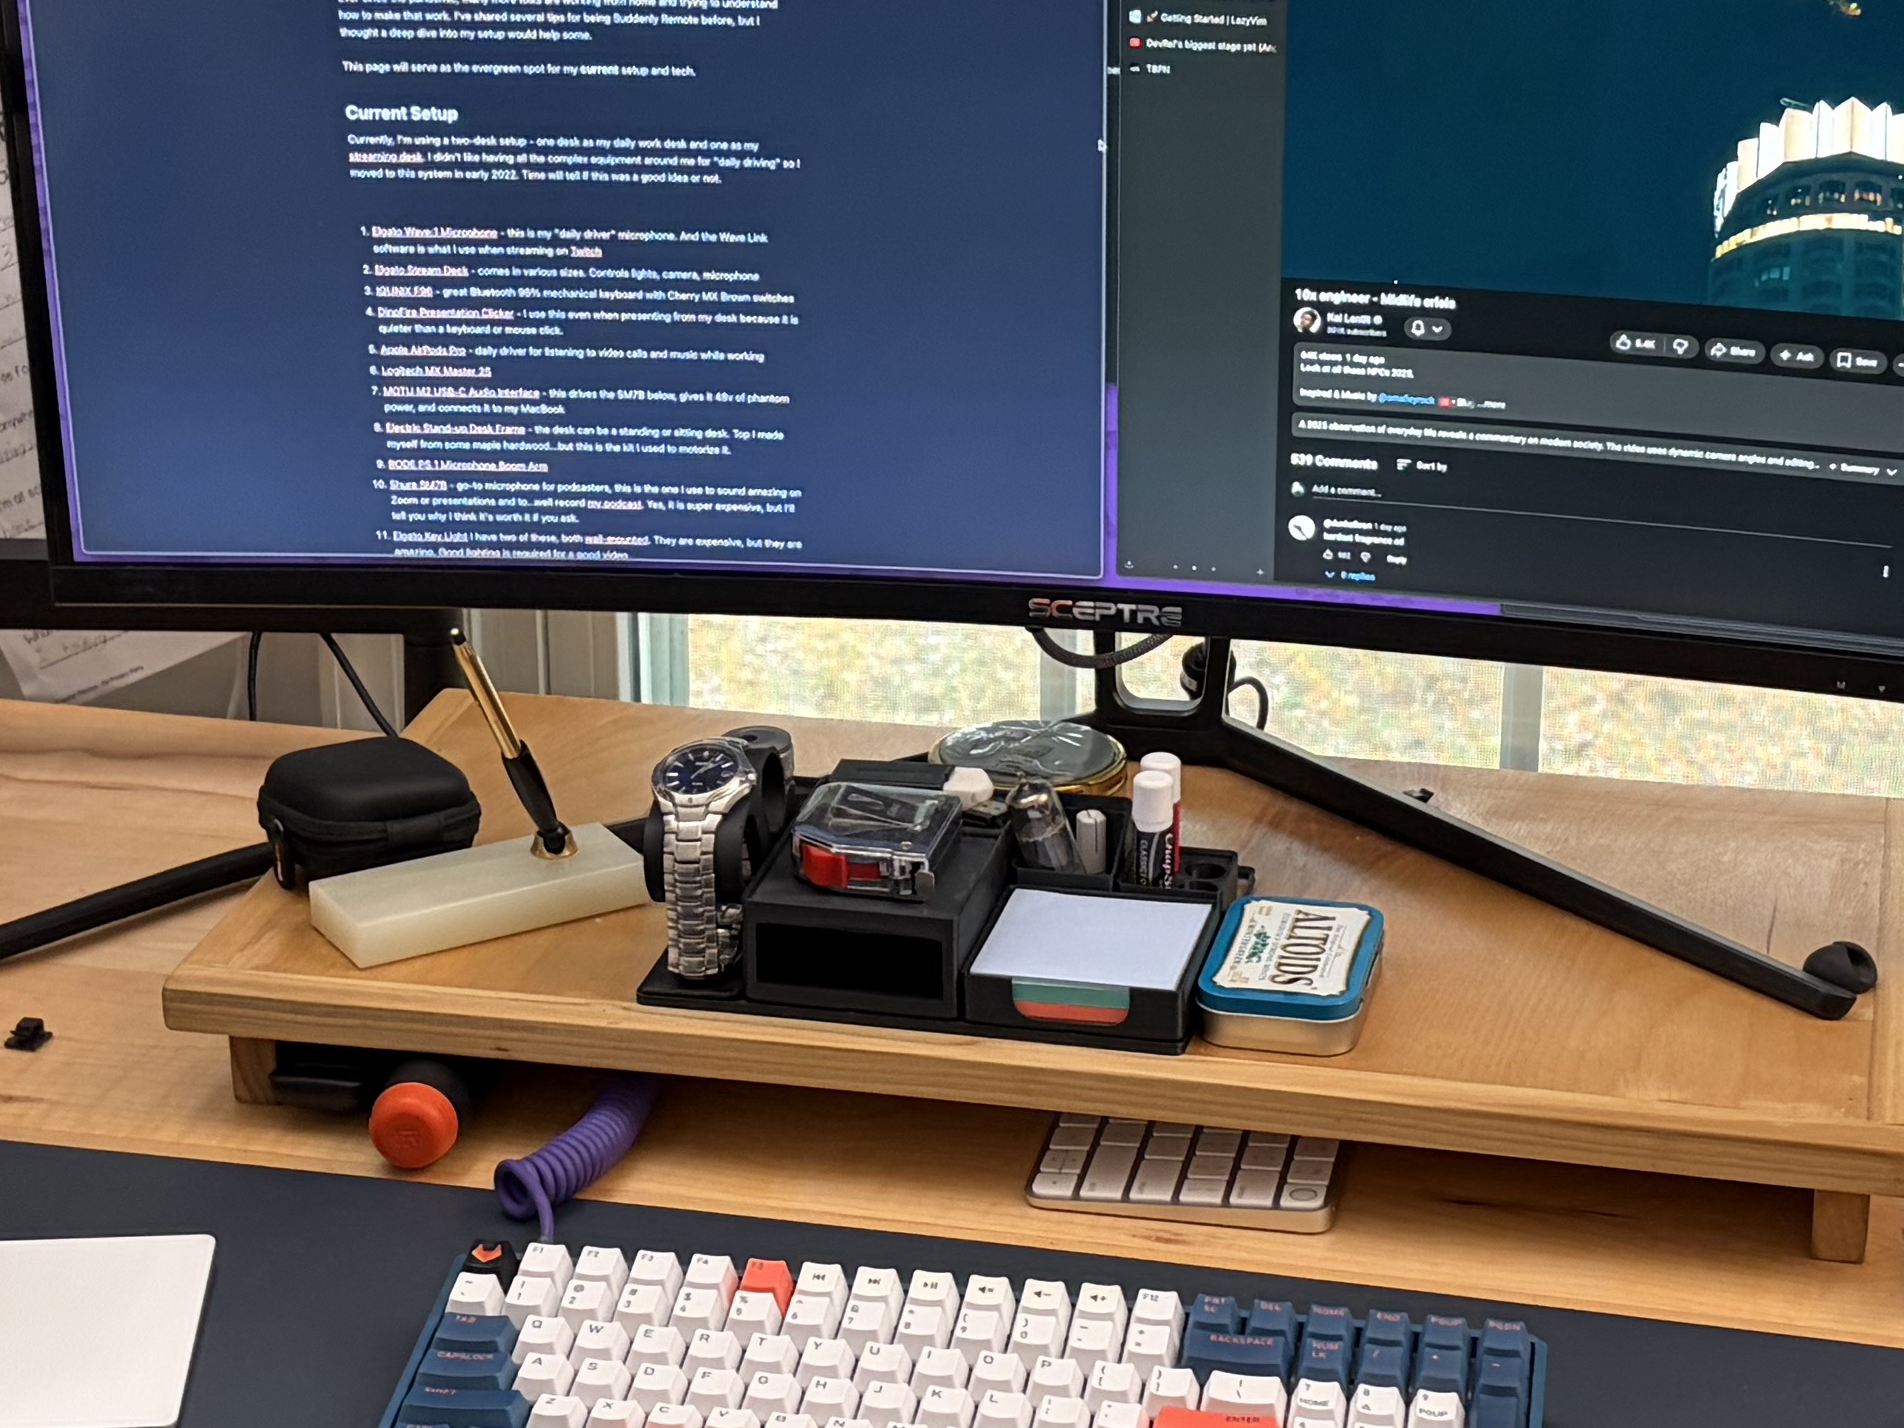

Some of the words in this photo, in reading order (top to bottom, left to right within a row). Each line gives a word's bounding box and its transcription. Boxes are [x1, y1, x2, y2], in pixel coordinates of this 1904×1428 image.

[345, 104, 407, 120] Current
[409, 105, 458, 124] Setup
[1314, 454, 1377, 470] Comments
[1028, 598, 1183, 627] SCEPTRE
[1269, 909, 1336, 988] ALTOIDS
